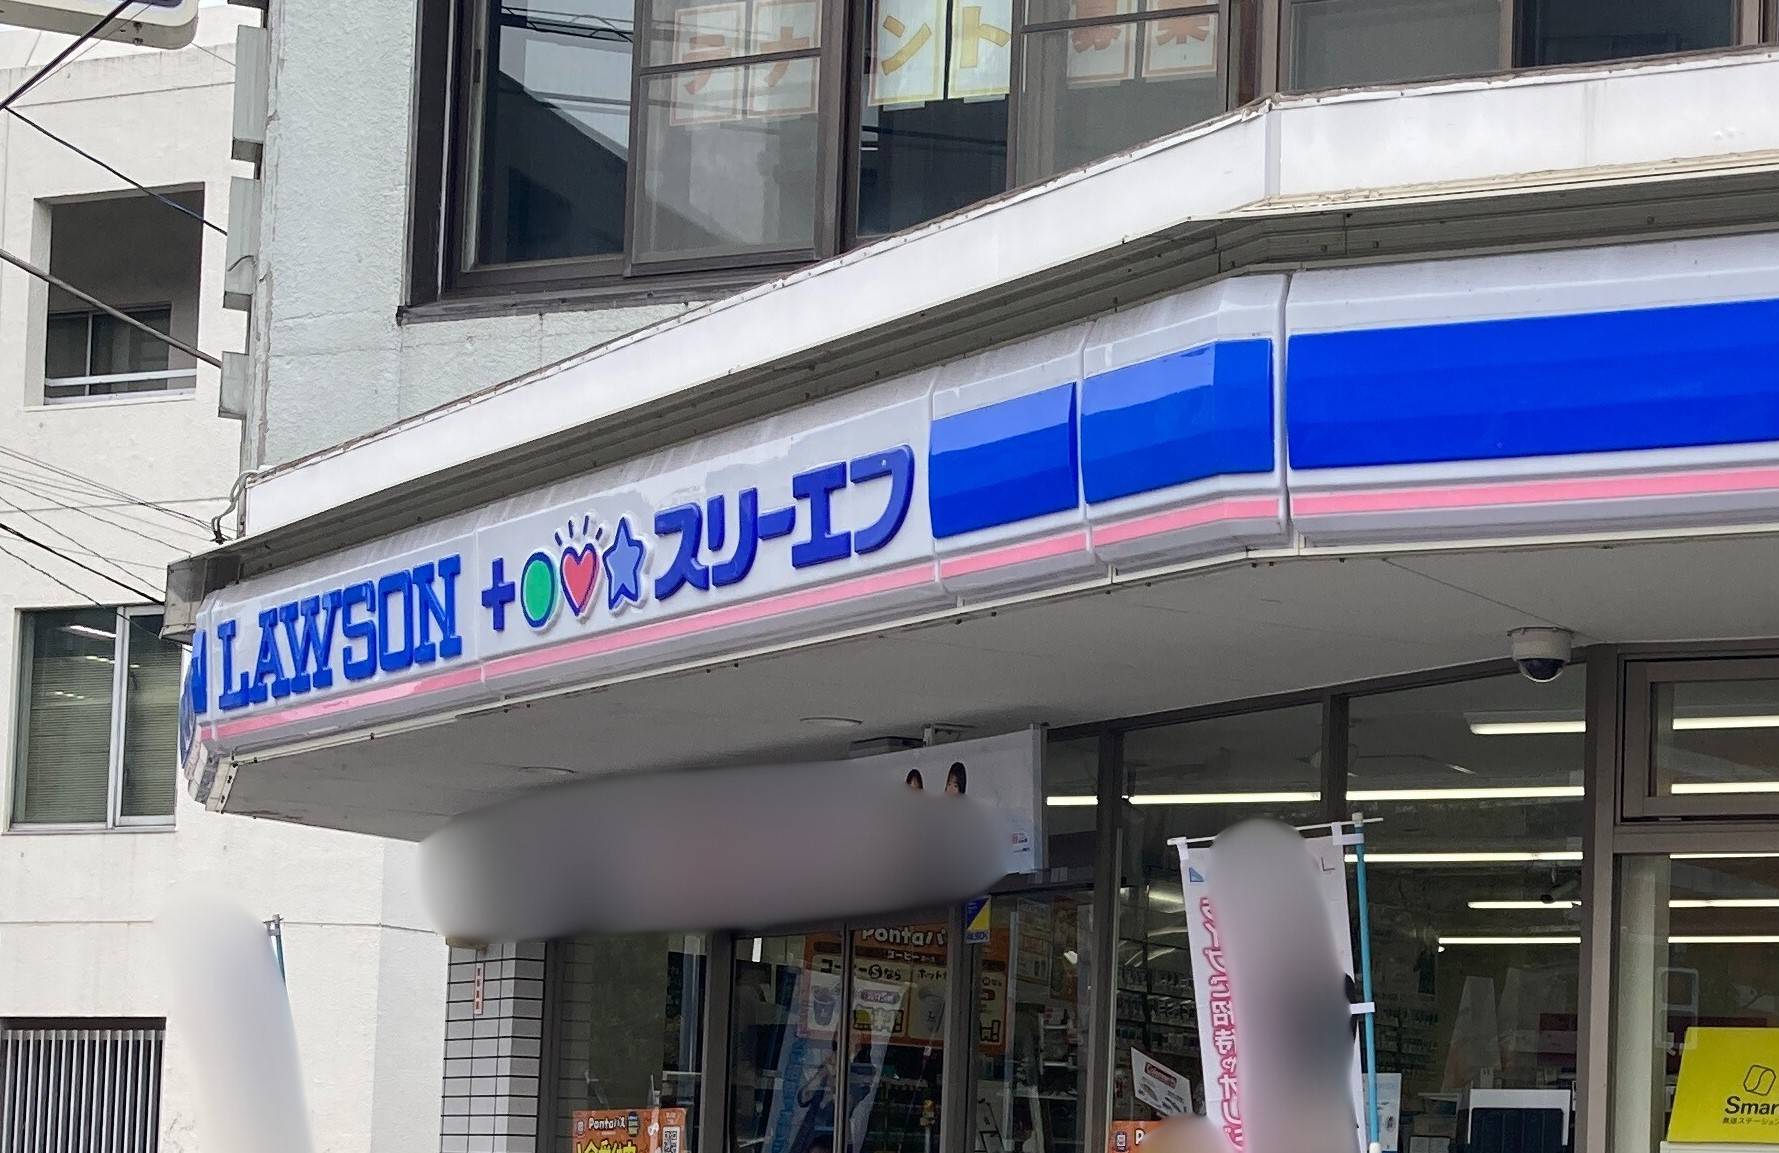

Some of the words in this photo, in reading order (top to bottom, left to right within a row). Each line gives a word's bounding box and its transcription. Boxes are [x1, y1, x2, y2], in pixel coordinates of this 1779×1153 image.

[217, 554, 462, 710] LAWSON
[654, 444, 914, 600] スリーエフ
